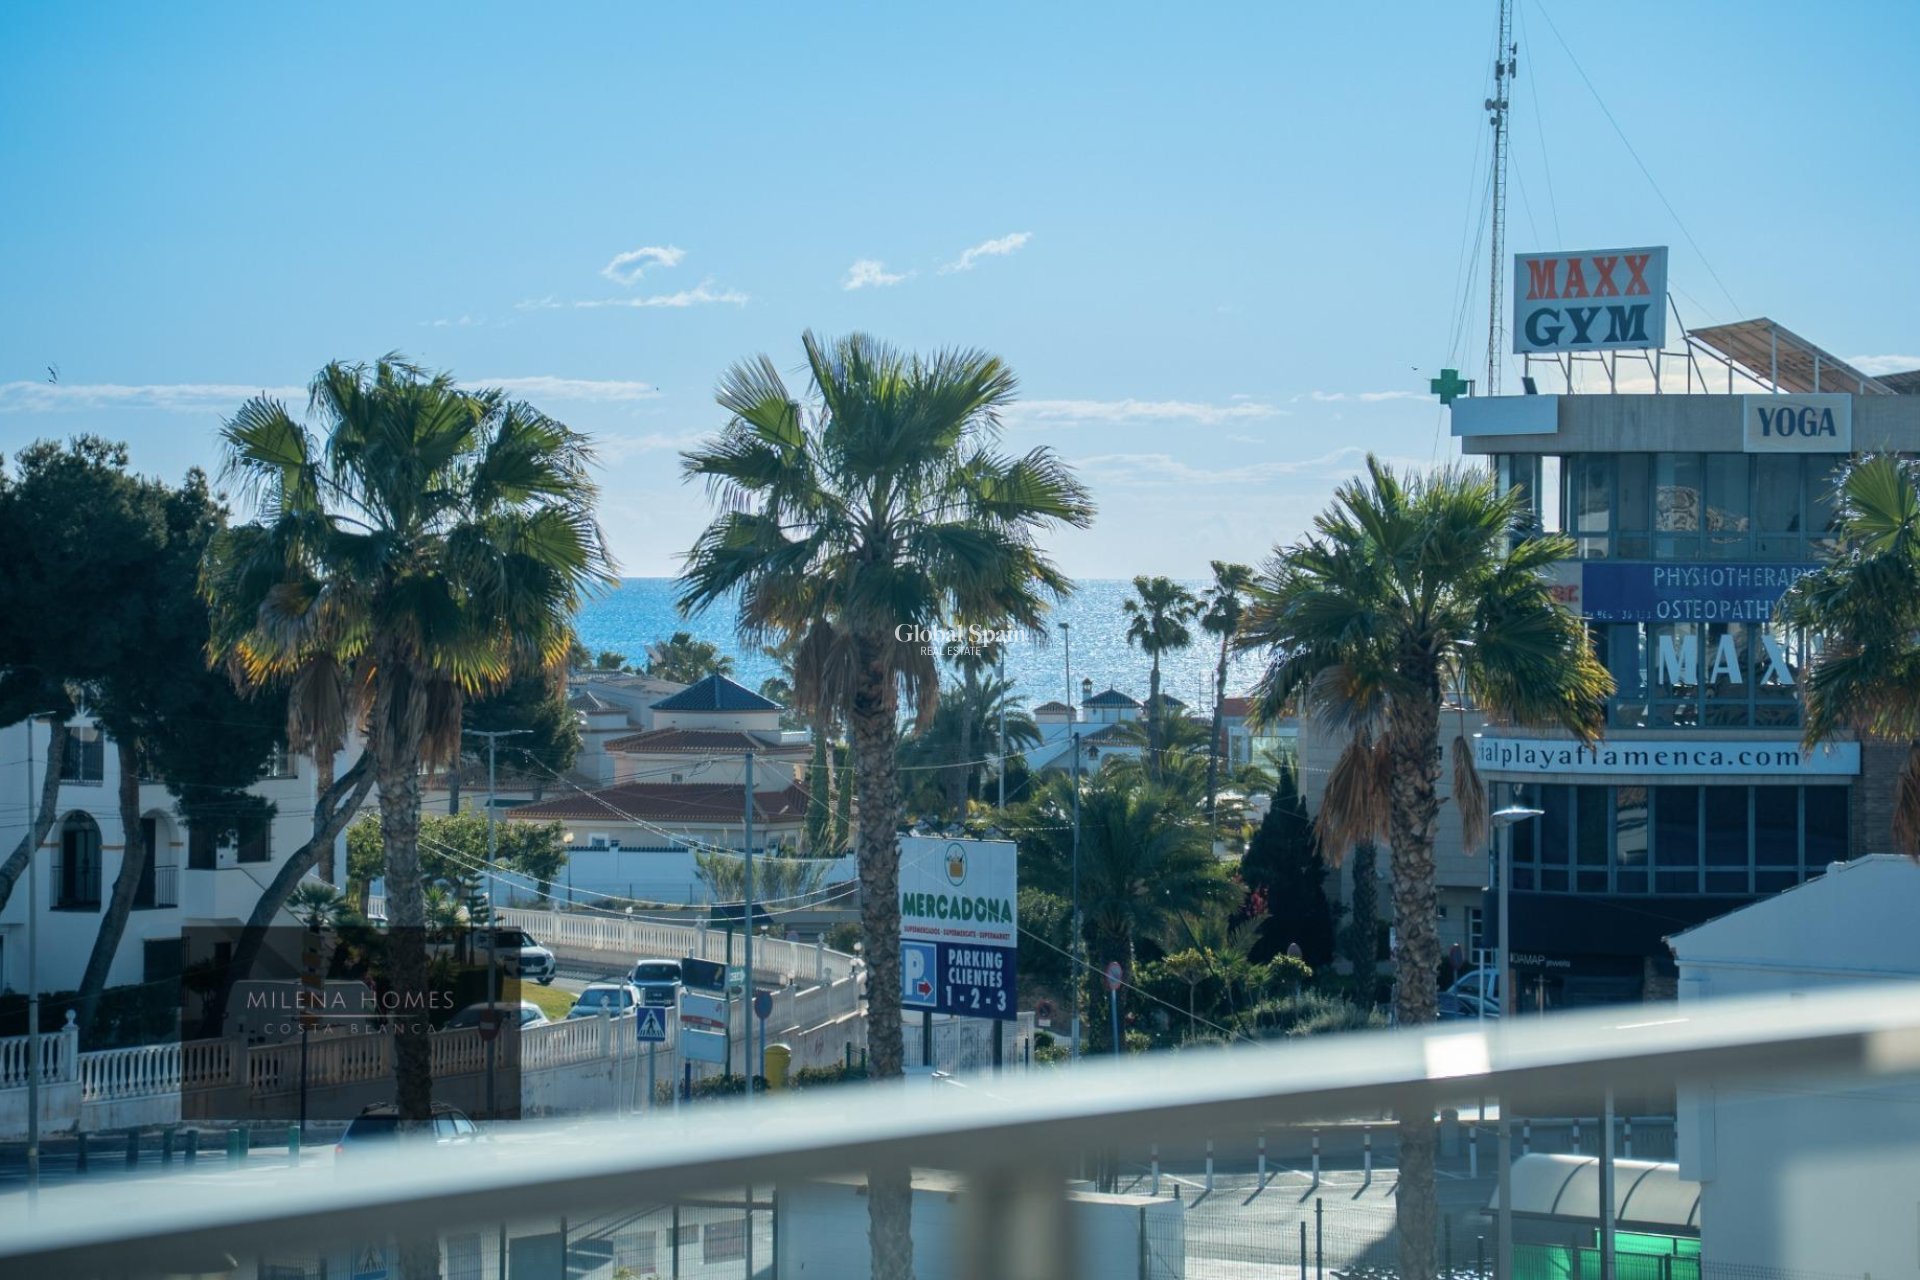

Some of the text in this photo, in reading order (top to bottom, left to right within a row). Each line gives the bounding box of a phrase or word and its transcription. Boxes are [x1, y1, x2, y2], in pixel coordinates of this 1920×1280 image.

[1526, 254, 1652, 300] MAXX
[1525, 303, 1650, 347] GYM
[1757, 407, 1837, 437] YOGA
[1658, 633, 1826, 686] MAX
[902, 892, 1012, 923] MERCADONA
[904, 948, 925, 997] P
[948, 949, 1003, 969] PARKING
[948, 967, 1003, 988] CLIENTES
